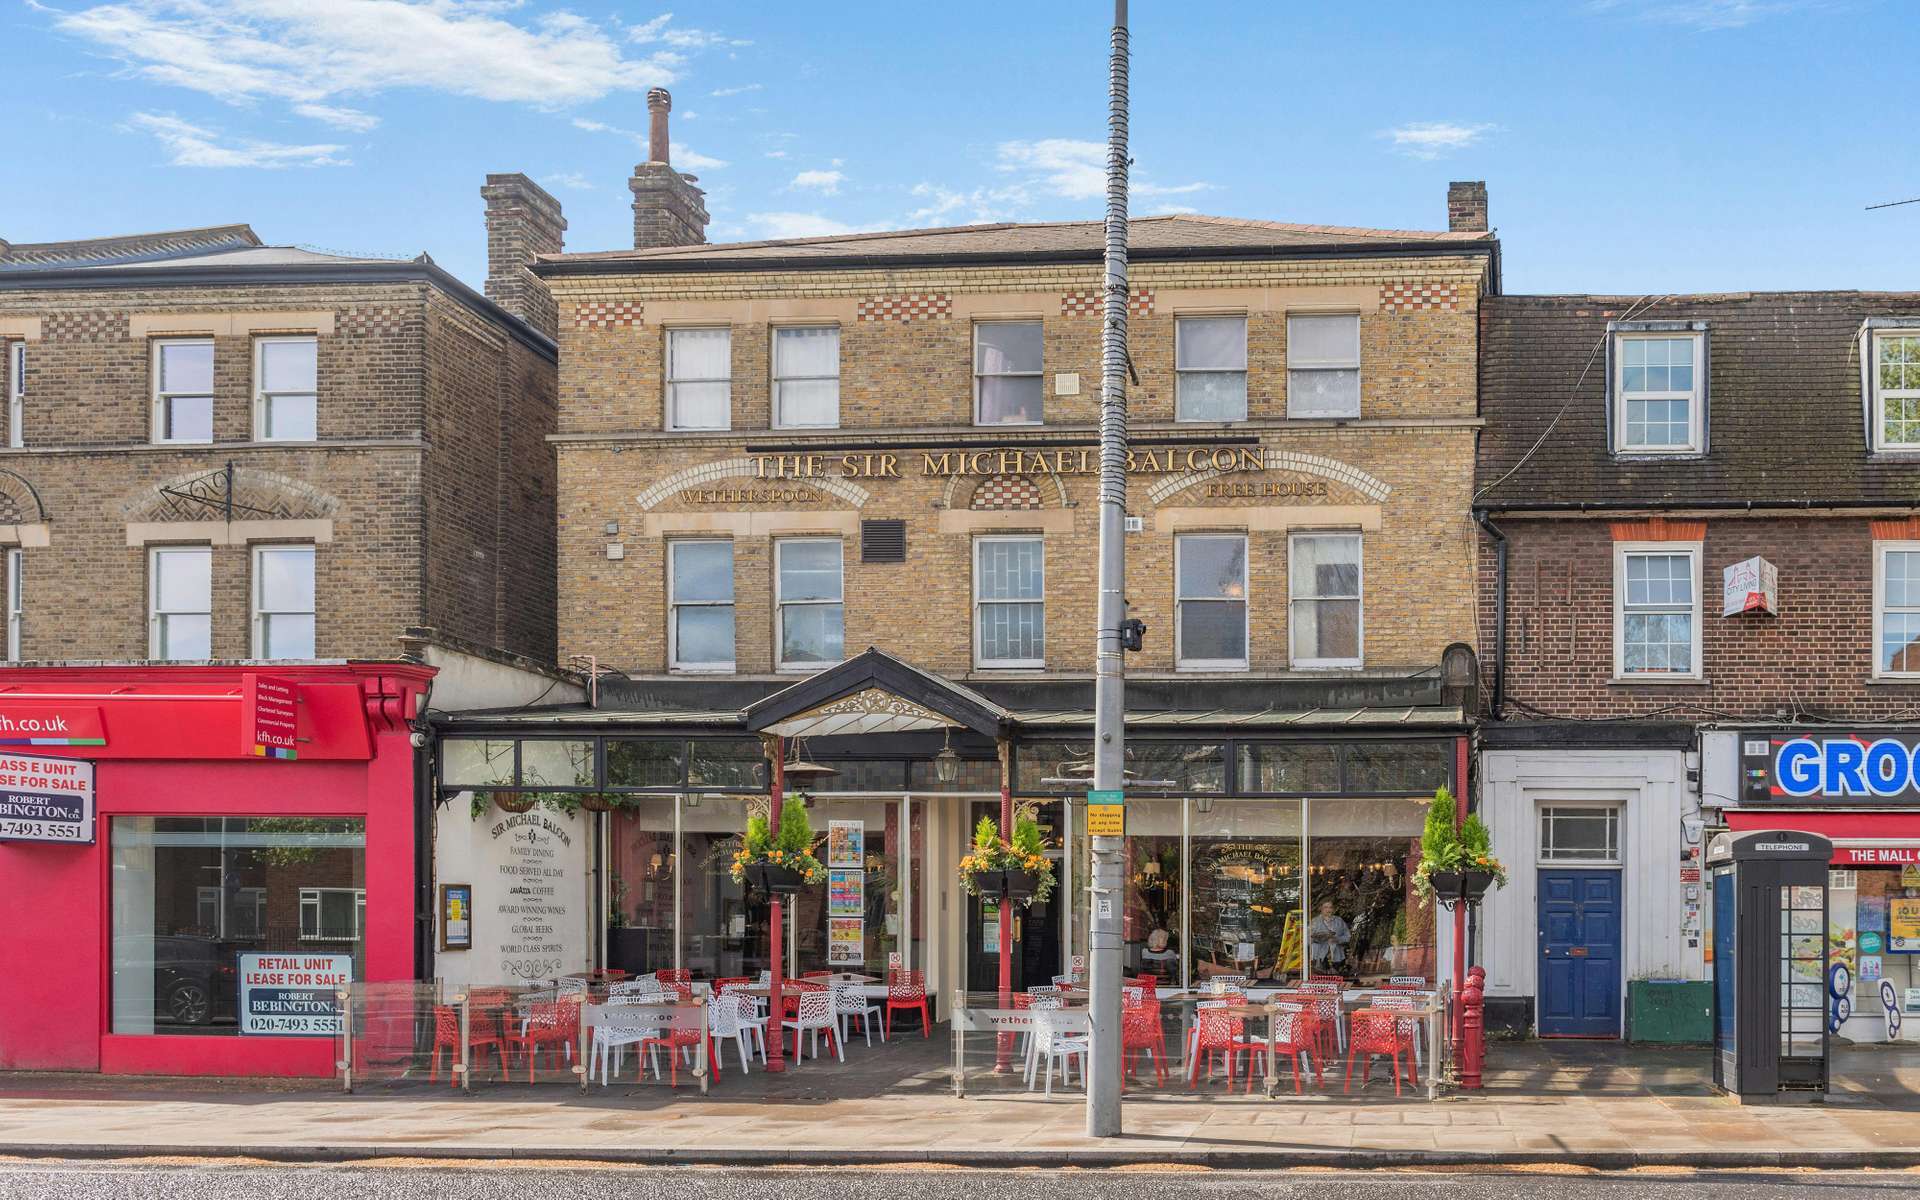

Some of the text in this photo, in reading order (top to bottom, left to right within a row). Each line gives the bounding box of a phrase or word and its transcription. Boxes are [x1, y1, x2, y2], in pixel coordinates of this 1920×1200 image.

[750, 454, 825, 479] THE
[840, 454, 902, 479] SIR
[920, 450, 1100, 476] MICHAEL
[1206, 481, 1328, 498] FREE HOUSE
[680, 489, 824, 504] WETHERSPOON
[0, 714, 68, 731] h.co.uk
[280, 721, 295, 730] Property
[257, 730, 295, 746] kfh.co.uk
[31, 762, 40, 773] E
[43, 763, 77, 775] UNIT
[1775, 738, 1920, 797] GRO
[20, 776, 48, 788] FOR
[51, 778, 87, 791] SALE
[8, 794, 51, 805] ROBERT
[0, 822, 81, 838] -7493 5551
[491, 813, 572, 848] SIR MICHAEL BALCON
[509, 846, 555, 858] FAMILY DINING
[1218, 851, 1253, 863] MICHAEL
[1849, 849, 1876, 862] THE
[1878, 849, 1915, 862] MALL
[499, 864, 564, 878] FOOD SERVED ALL DAY
[532, 886, 555, 896] COFFEE
[498, 904, 566, 915] AWARD WINNING WINES
[511, 925, 553, 934] GLOBAL BEERS
[500, 943, 563, 953] WORLD CLASS SPIRITS
[258, 958, 333, 970] RETAIL UNIT
[246, 973, 346, 985] LEASE FOR SALE
[278, 992, 314, 1001] ROBERT
[252, 1000, 330, 1013] BEBINGTON
[250, 1018, 343, 1031] 020-7493 5551
